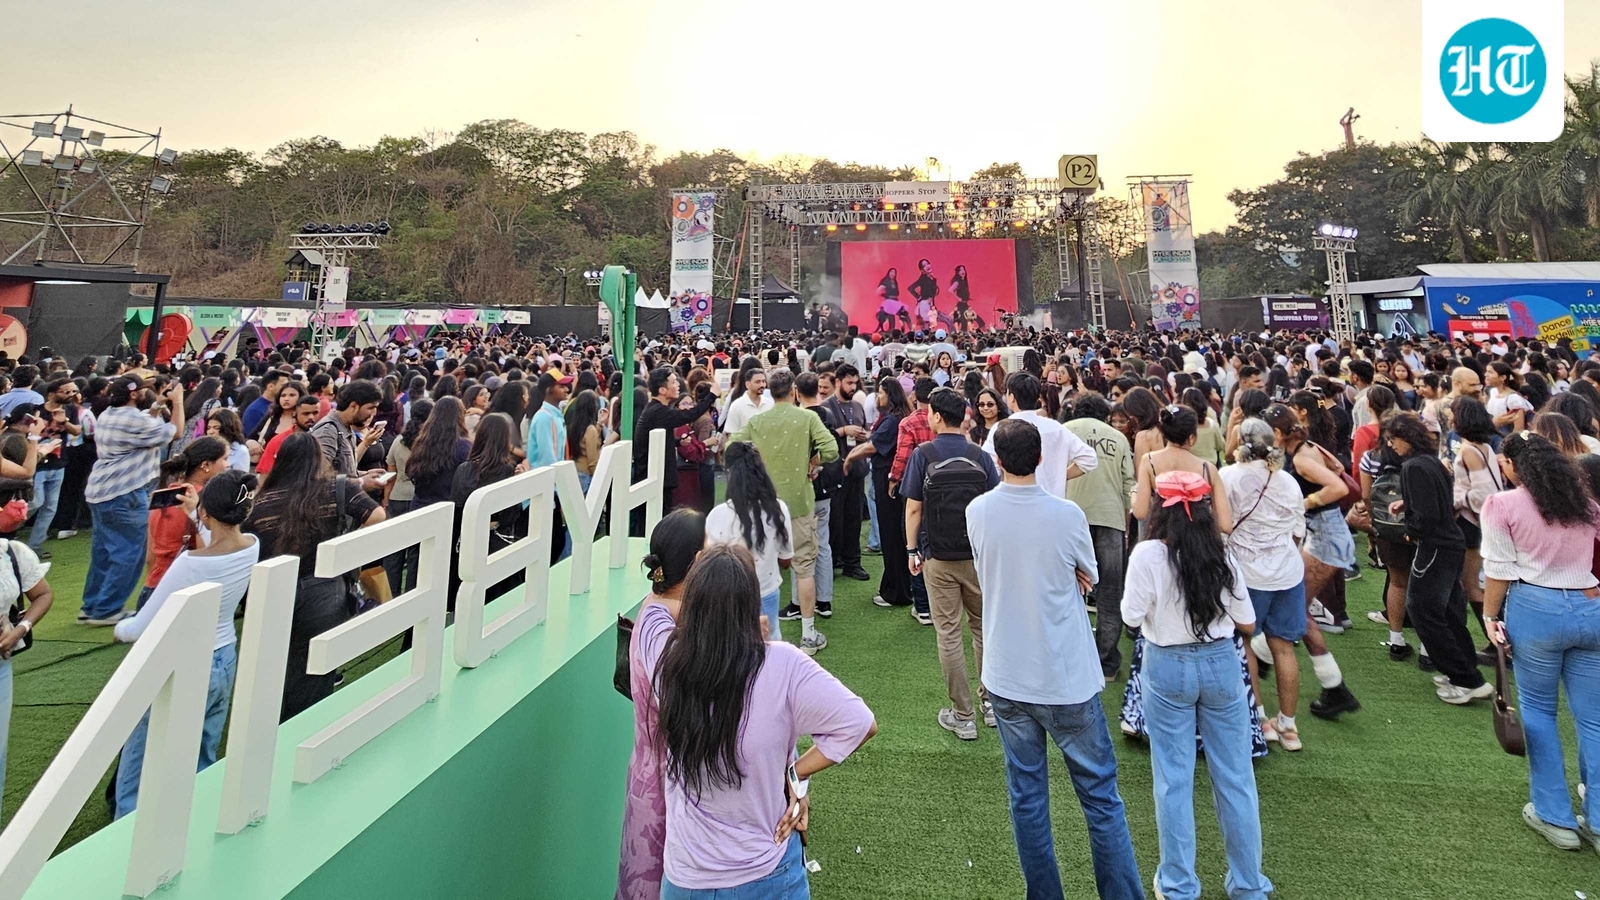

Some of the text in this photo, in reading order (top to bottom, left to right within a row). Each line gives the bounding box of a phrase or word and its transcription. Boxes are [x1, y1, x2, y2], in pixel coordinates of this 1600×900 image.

[1071, 163, 1093, 178] P2
[1379, 298, 1413, 310] SAMSUNG
[1541, 317, 1572, 333] Dance
